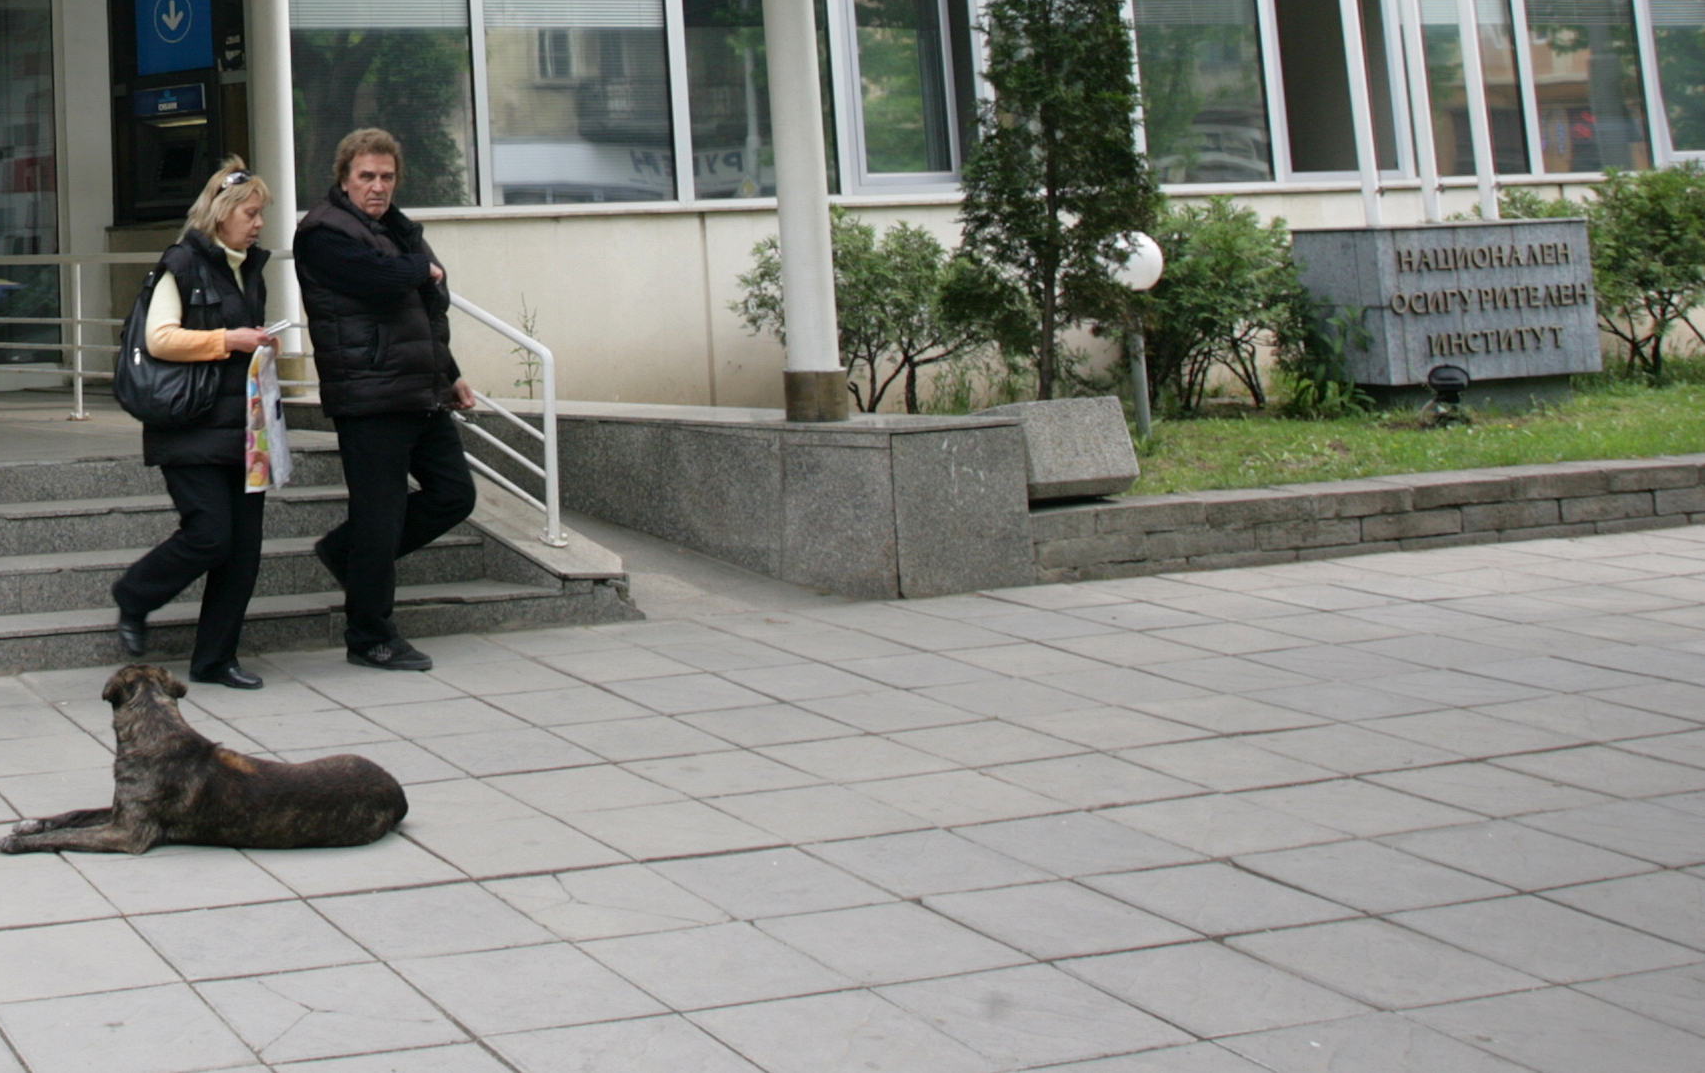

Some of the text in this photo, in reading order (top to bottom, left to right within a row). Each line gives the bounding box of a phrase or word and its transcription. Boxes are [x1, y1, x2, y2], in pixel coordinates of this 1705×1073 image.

[1397, 242, 1571, 273] НАЦИОНАЛЕН
[1391, 283, 1589, 316] ОСИГУРИТЕЛЕН
[1427, 326, 1563, 357] ИНСТИТУТ
